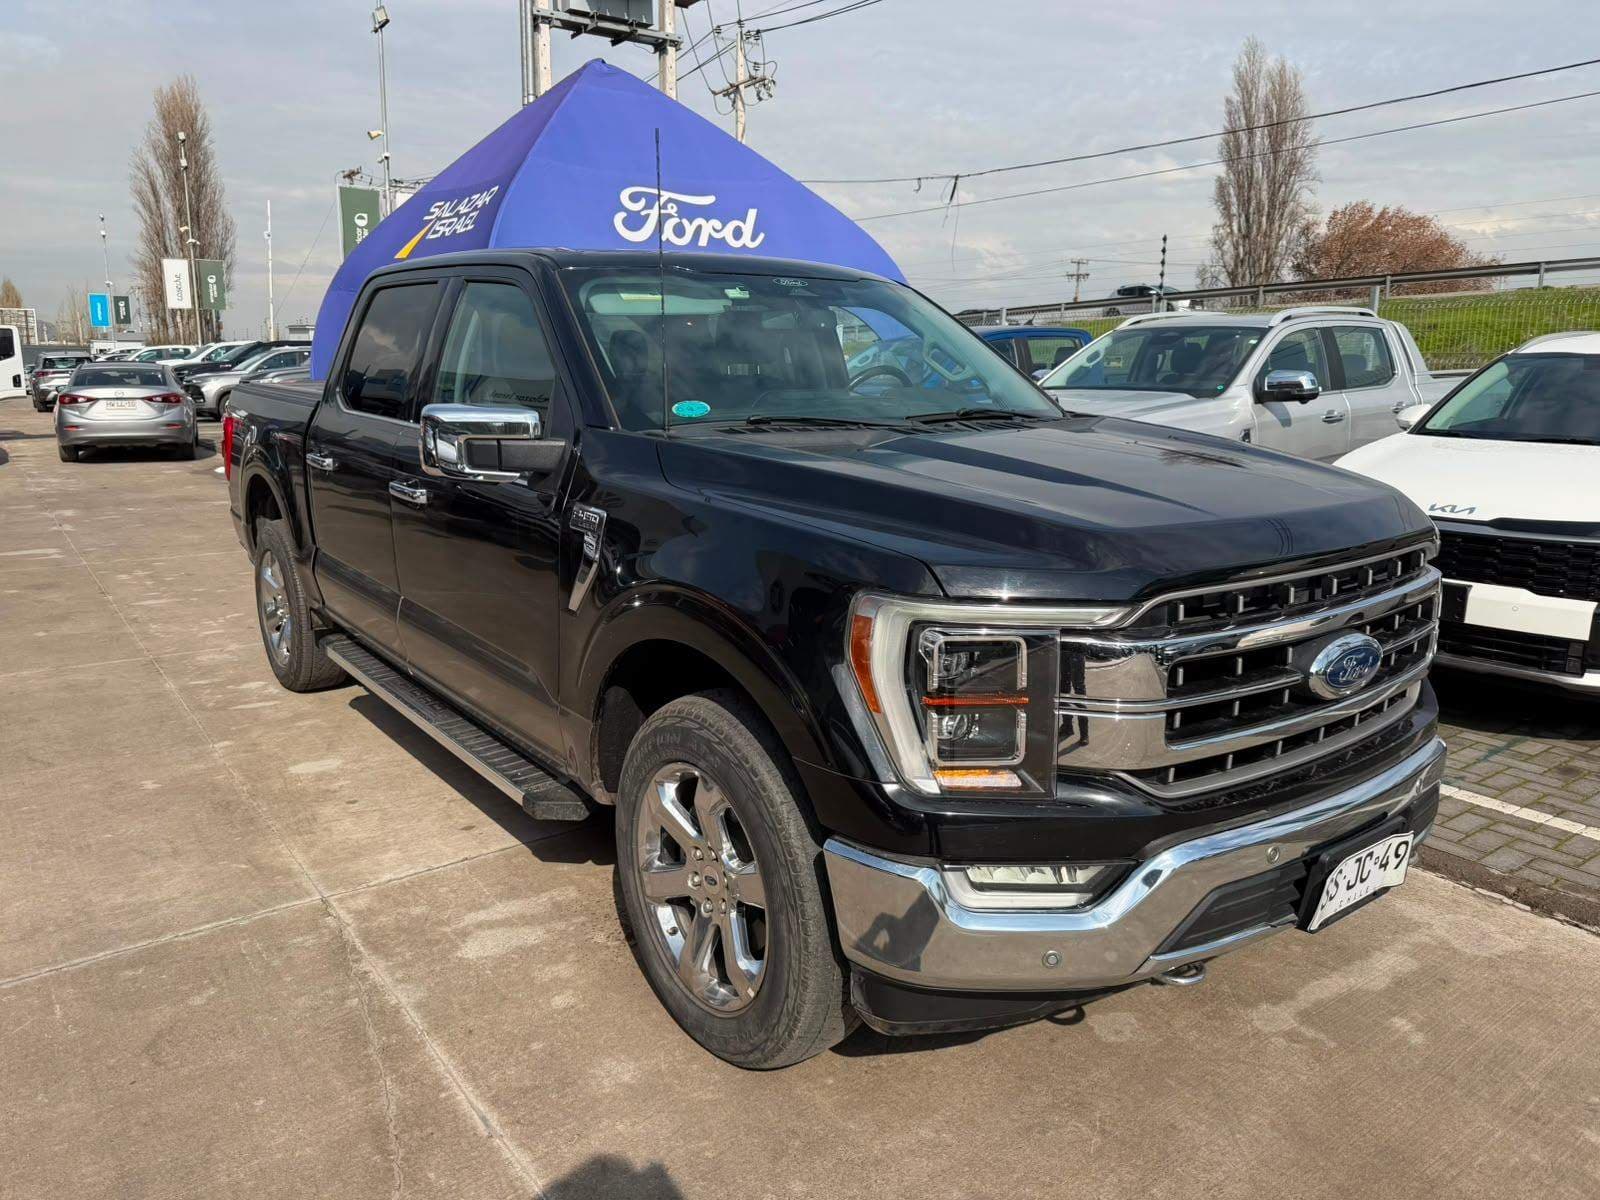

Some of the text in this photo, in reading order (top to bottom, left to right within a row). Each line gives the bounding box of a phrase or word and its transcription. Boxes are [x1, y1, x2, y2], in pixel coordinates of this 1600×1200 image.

[423, 185, 499, 221] SALAZAR
[613, 186, 765, 248] Ford
[425, 210, 480, 240] ISRAEL
[1339, 652, 1374, 682] Ford
